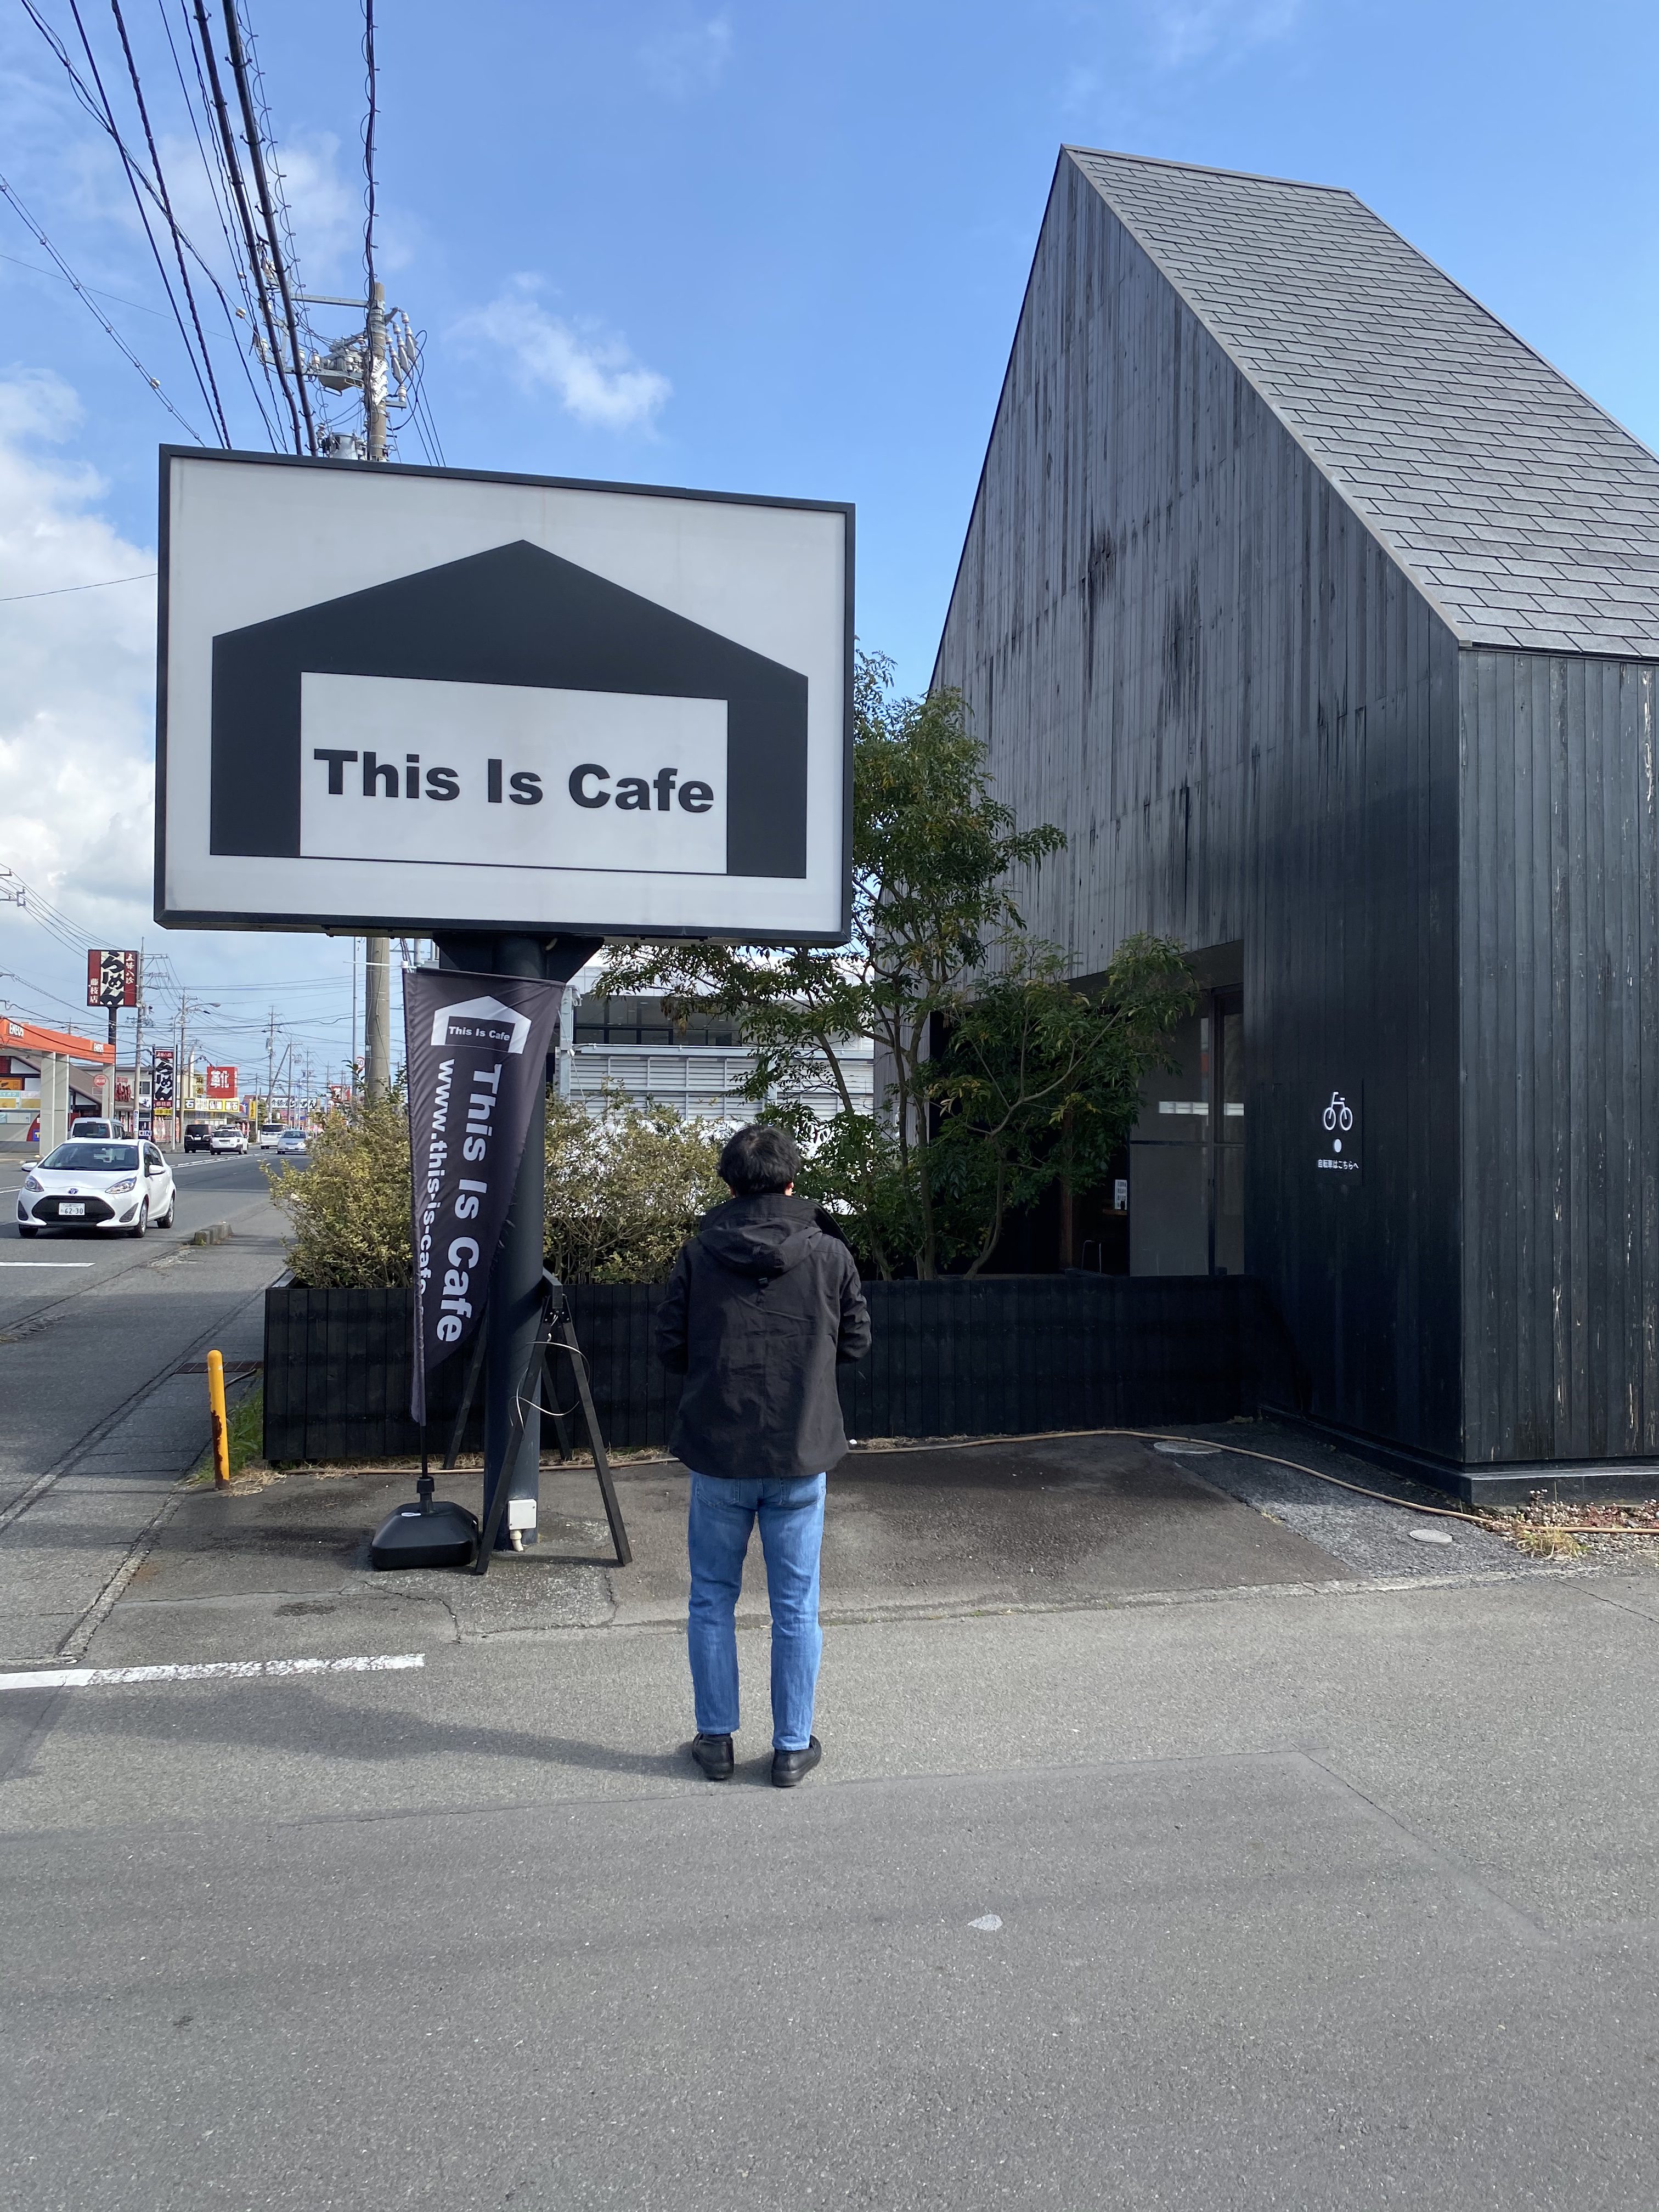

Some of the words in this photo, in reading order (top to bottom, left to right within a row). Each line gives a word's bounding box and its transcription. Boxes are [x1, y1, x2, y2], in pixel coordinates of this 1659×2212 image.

[314, 748, 460, 801] This
[488, 758, 543, 805] Is
[569, 763, 714, 813] Cafe
[449, 1026, 472, 1036] This
[476, 1028, 486, 1037] Is
[489, 1030, 511, 1041] Cafe
[463, 1064, 502, 1161] This
[1318, 1159, 1359, 1170] 自転車はこちらへ
[455, 1179, 487, 1219] Is
[437, 1237, 479, 1342] Cafe
